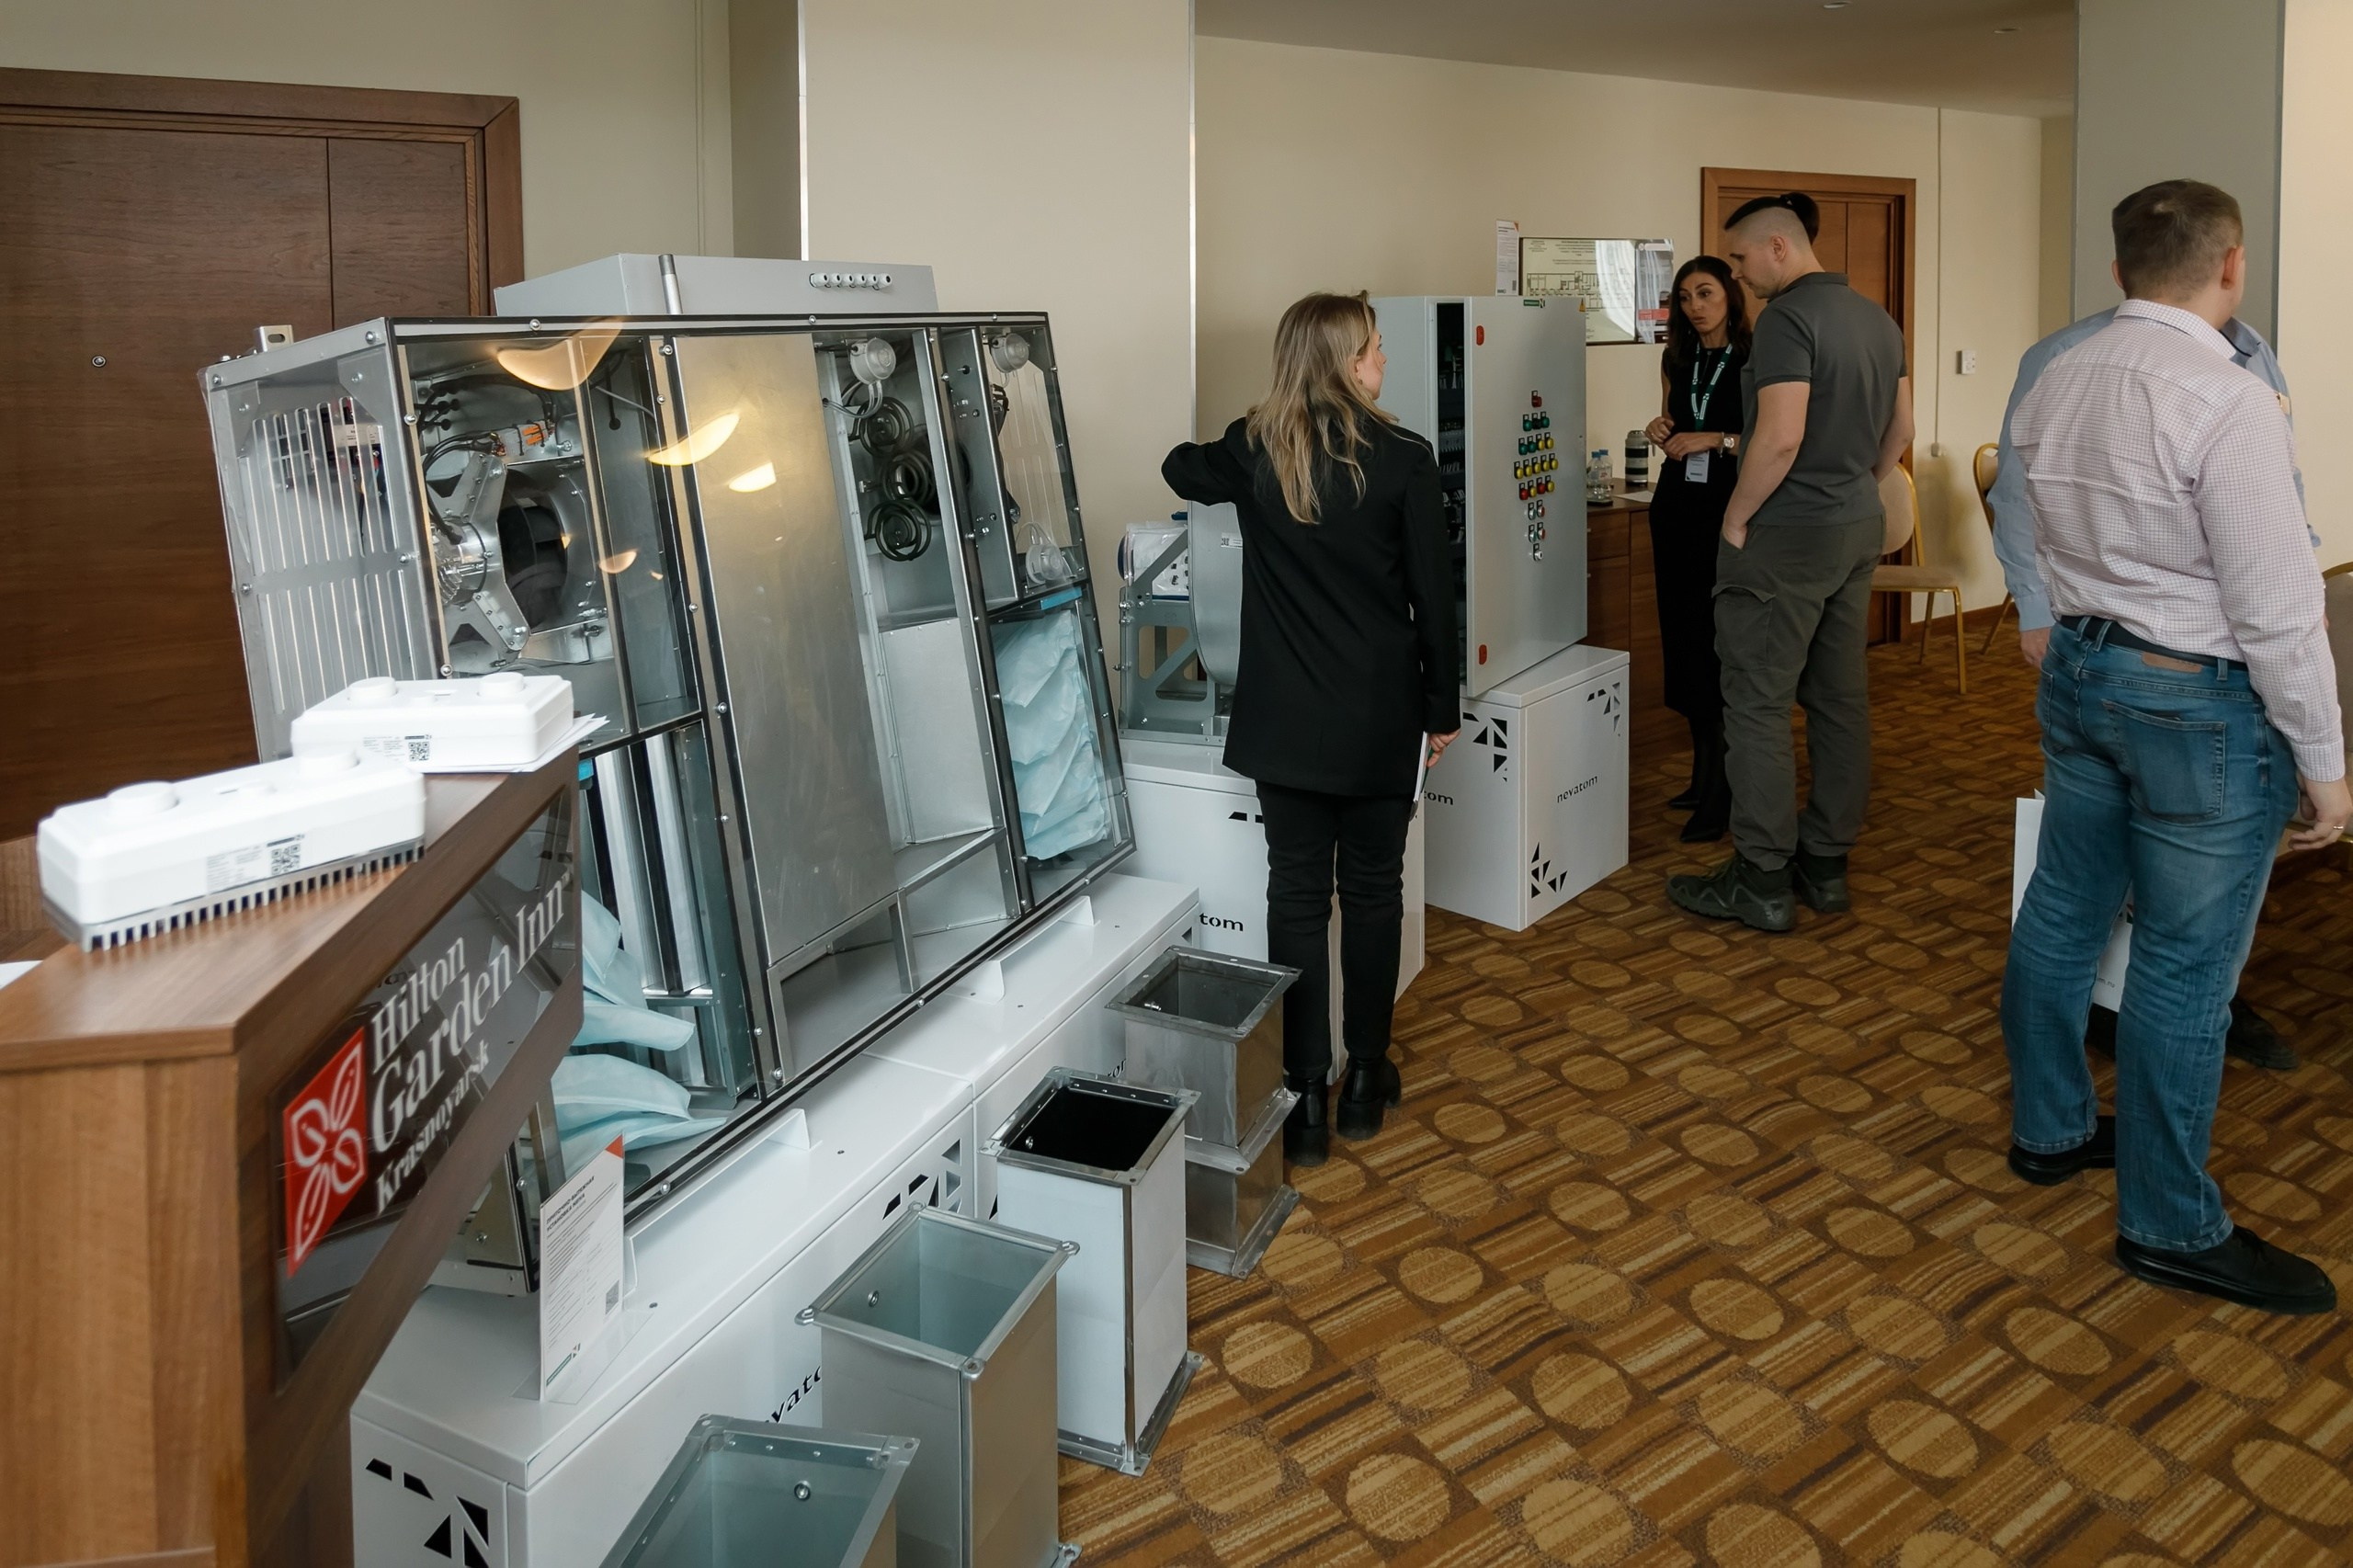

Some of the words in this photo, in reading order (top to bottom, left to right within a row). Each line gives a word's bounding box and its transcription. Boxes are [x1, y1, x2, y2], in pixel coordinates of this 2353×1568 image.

[1556, 775, 1598, 804] nevatom
[370, 937, 466, 1075] Hilton
[372, 944, 513, 1153] Garden
[515, 881, 564, 974] Inn
[376, 1039, 490, 1217] Krasnoyarsk
